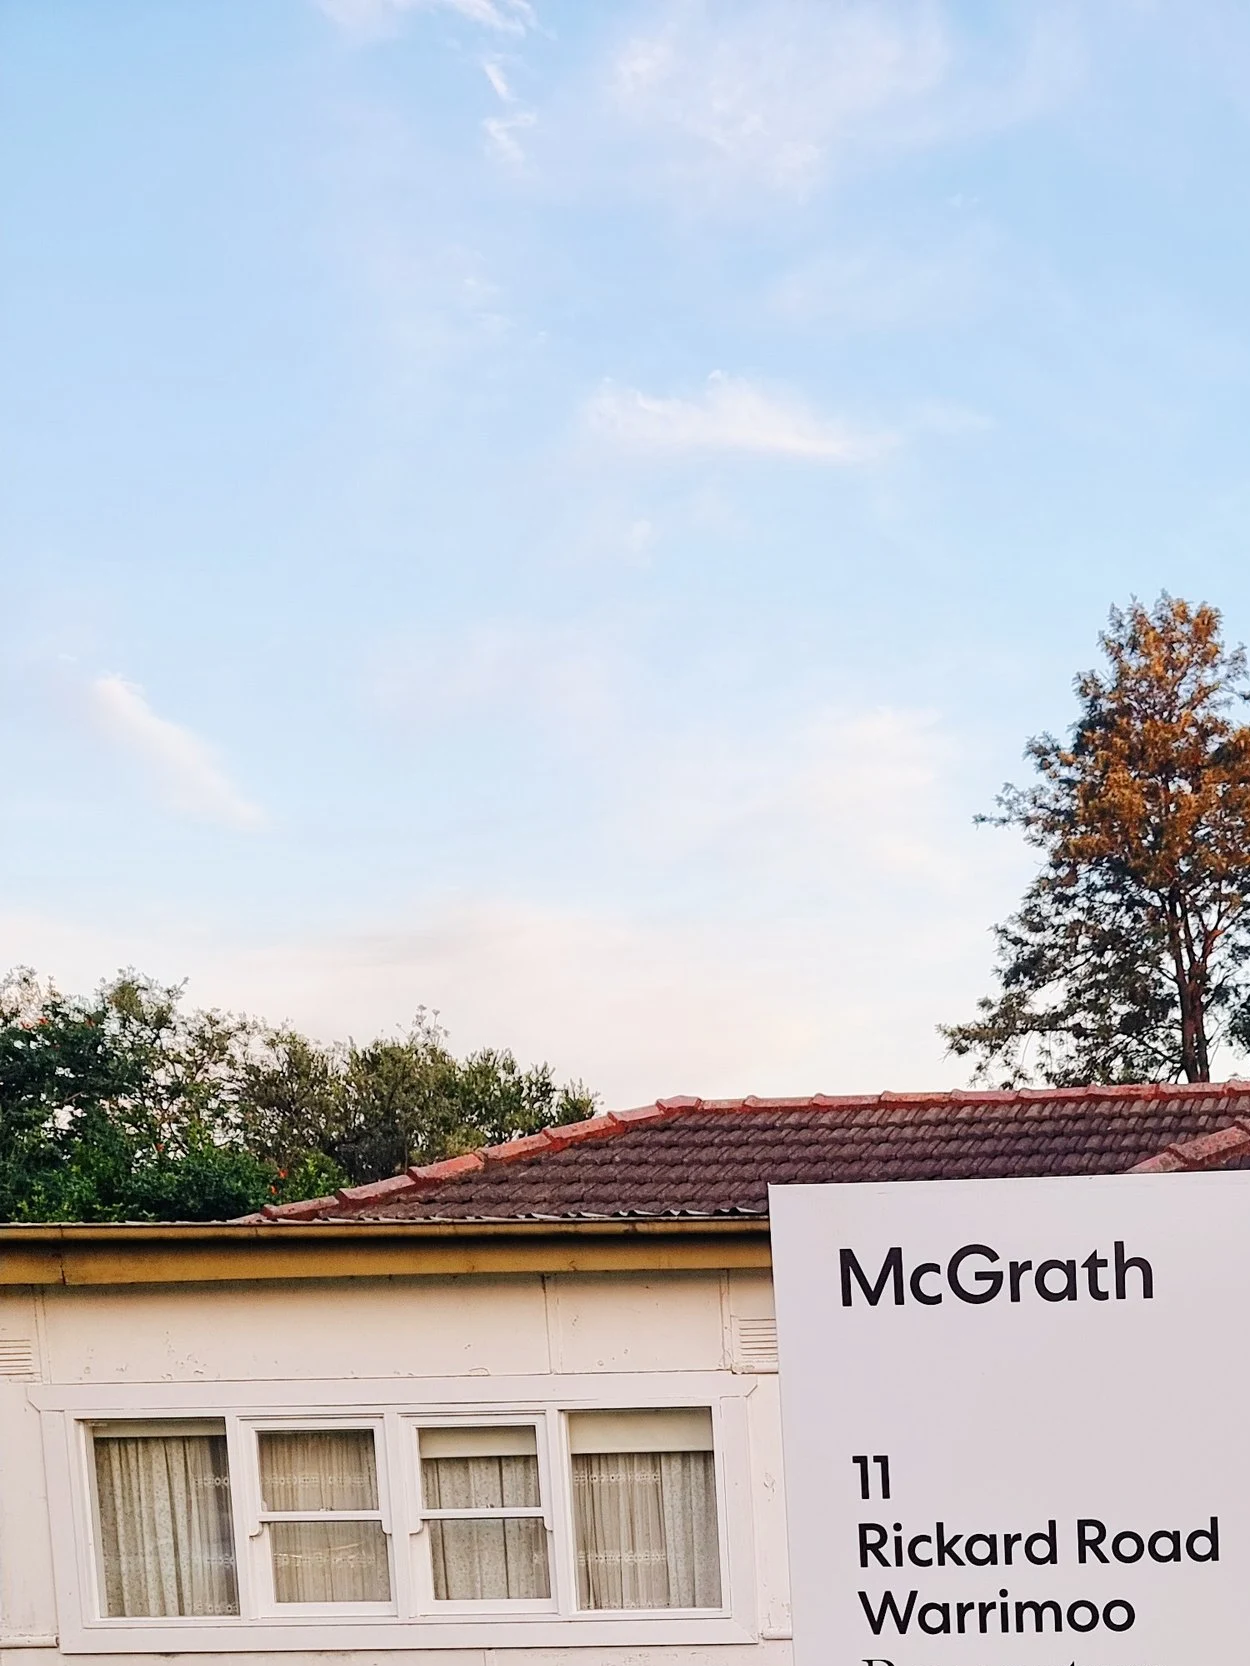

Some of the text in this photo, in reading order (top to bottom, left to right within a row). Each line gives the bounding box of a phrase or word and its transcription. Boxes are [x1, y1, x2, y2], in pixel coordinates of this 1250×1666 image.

[839, 1240, 1153, 1307] McGrath
[851, 1454, 890, 1499] 11
[857, 1516, 1219, 1567] Rickard Road
[857, 1588, 1135, 1635] Warrimoo
